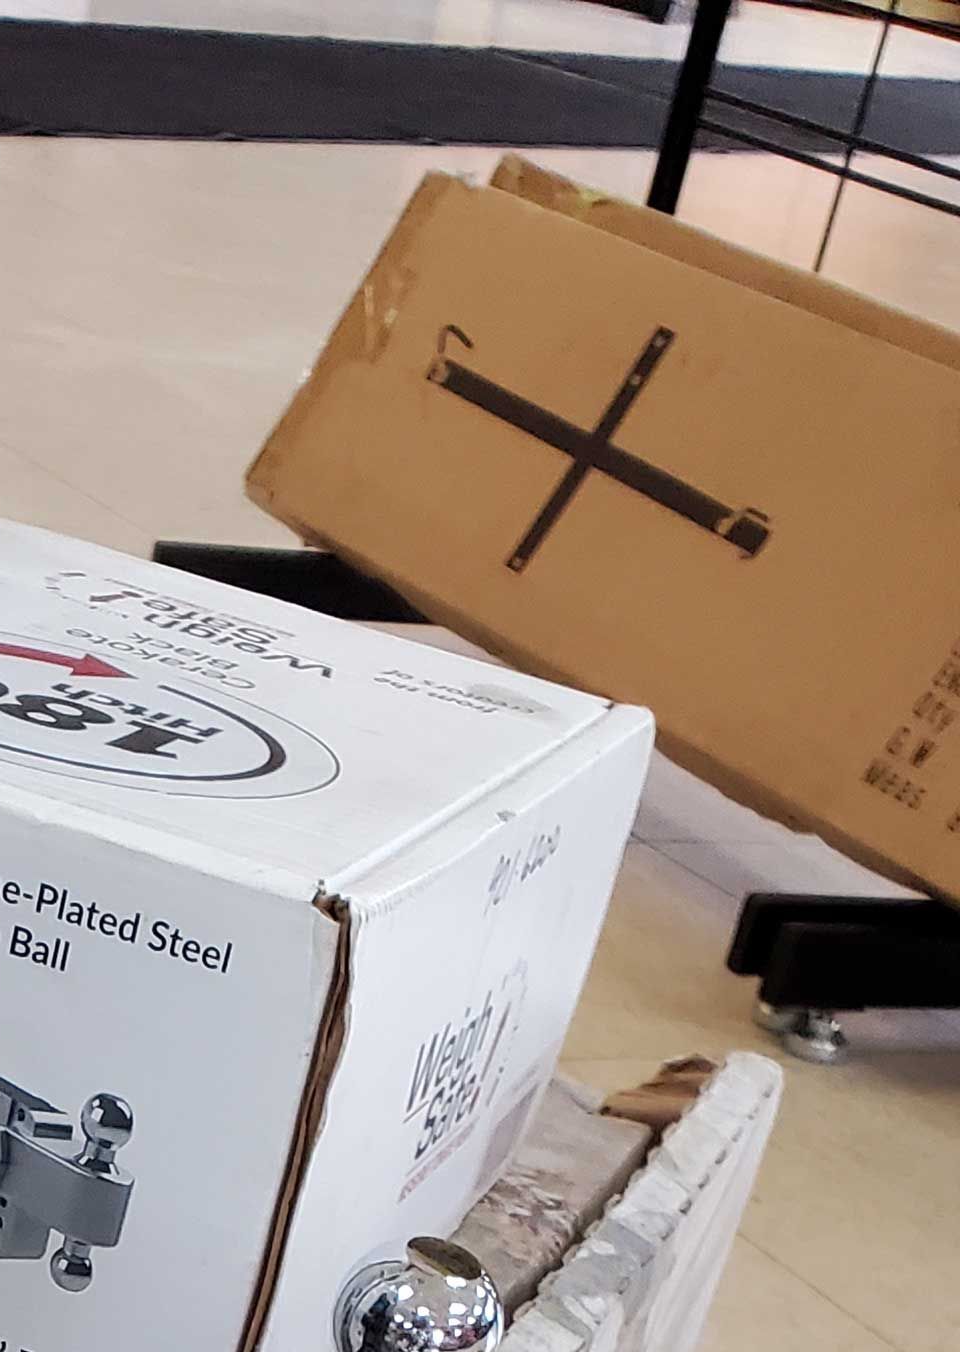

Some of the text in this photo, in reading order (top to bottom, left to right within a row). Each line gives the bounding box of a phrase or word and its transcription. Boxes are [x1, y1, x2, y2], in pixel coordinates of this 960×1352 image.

[142, 599, 279, 645] Safe
[144, 613, 333, 679] Weigh
[66, 628, 256, 689] Cerakote
[129, 632, 239, 670] Black
[381, 670, 414, 680] of
[51, 683, 223, 737] Hitch
[374, 677, 498, 713] from the
[9, 927, 72, 972] Ball
[147, 921, 233, 974] Steel
[406, 990, 493, 1113] Weigh
[414, 1073, 481, 1160] Safe
